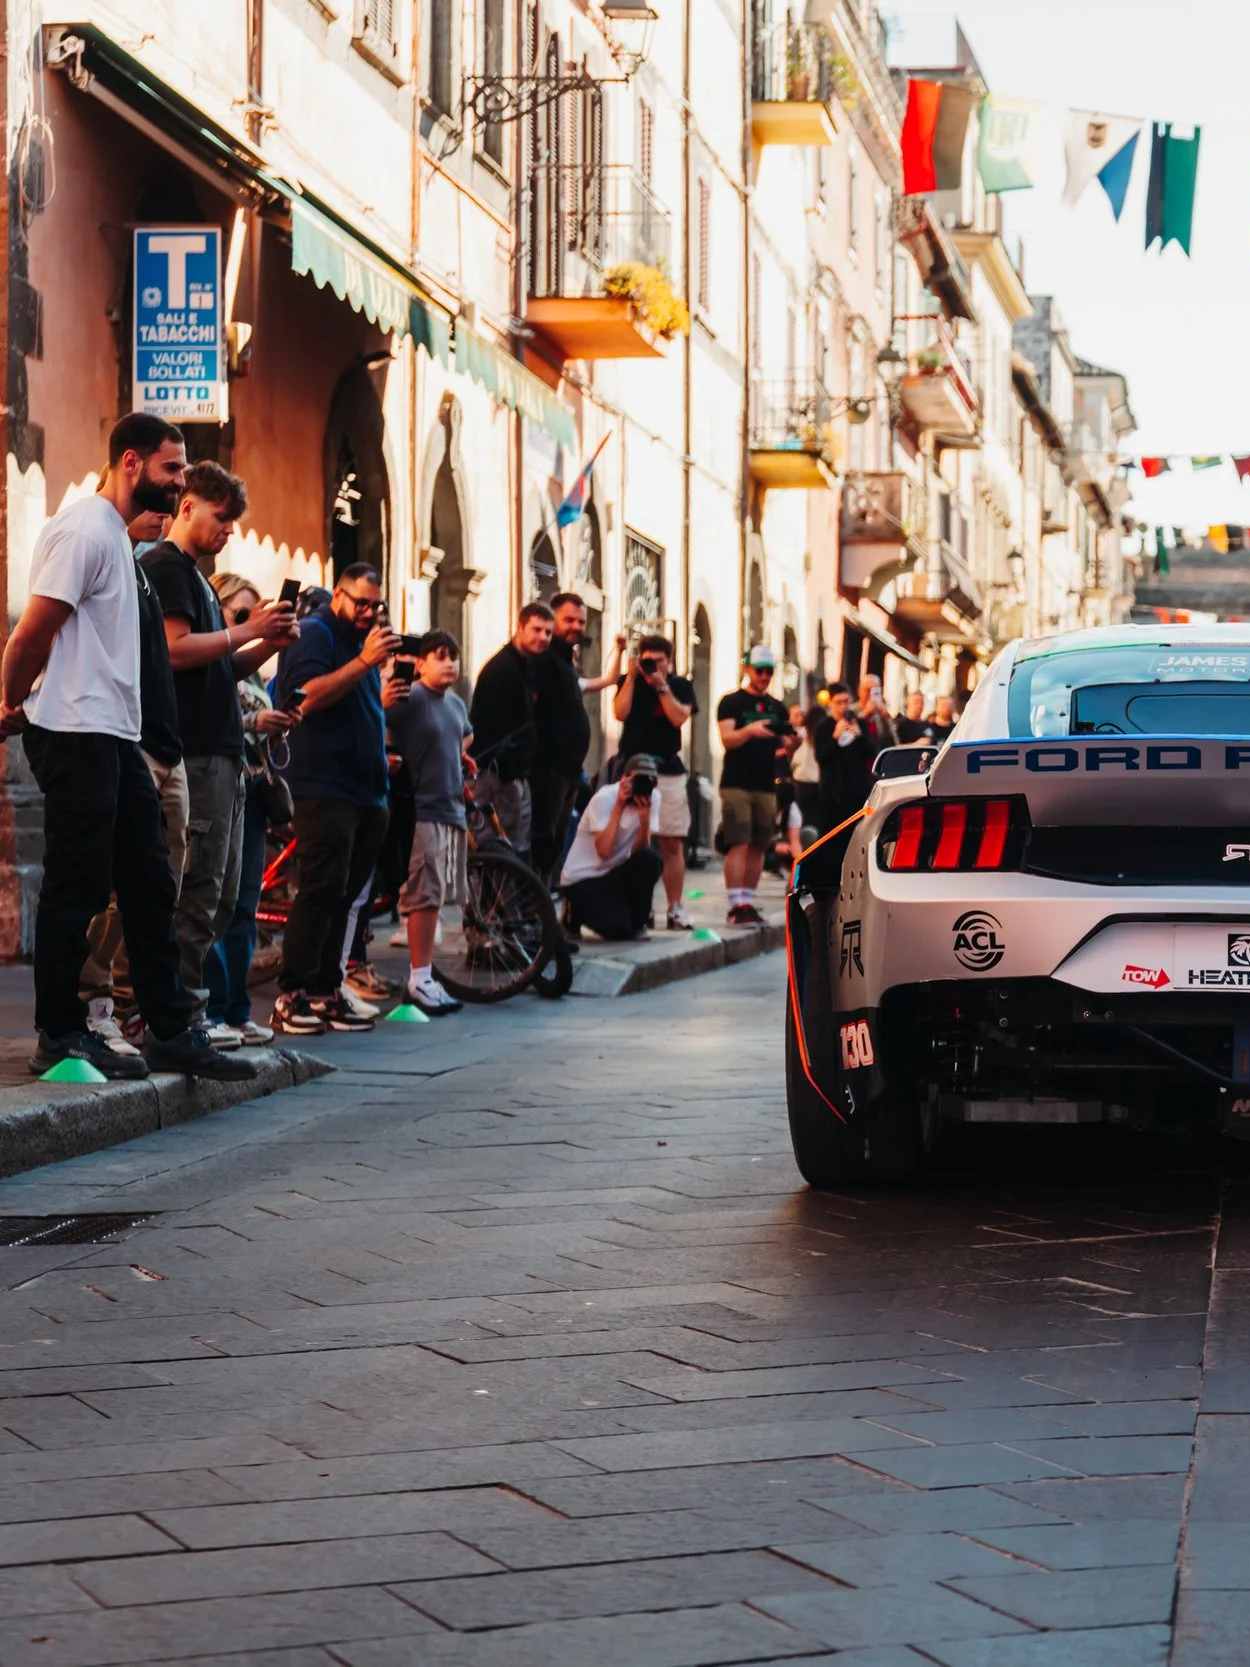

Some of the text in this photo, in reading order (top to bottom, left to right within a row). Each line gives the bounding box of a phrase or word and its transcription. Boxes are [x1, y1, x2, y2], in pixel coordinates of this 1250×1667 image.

[148, 235, 206, 309] T
[156, 312, 198, 325] SALI E
[140, 325, 215, 343] TABACCHI
[152, 352, 203, 365] VALORI
[148, 365, 206, 379] BOLLATI
[144, 387, 209, 400] LOTTO
[1159, 656, 1247, 666] JAMES
[966, 746, 1202, 774] FORD
[953, 932, 1006, 951] ACL
[1122, 970, 1160, 983] TOW
[839, 1019, 875, 1070] 130
